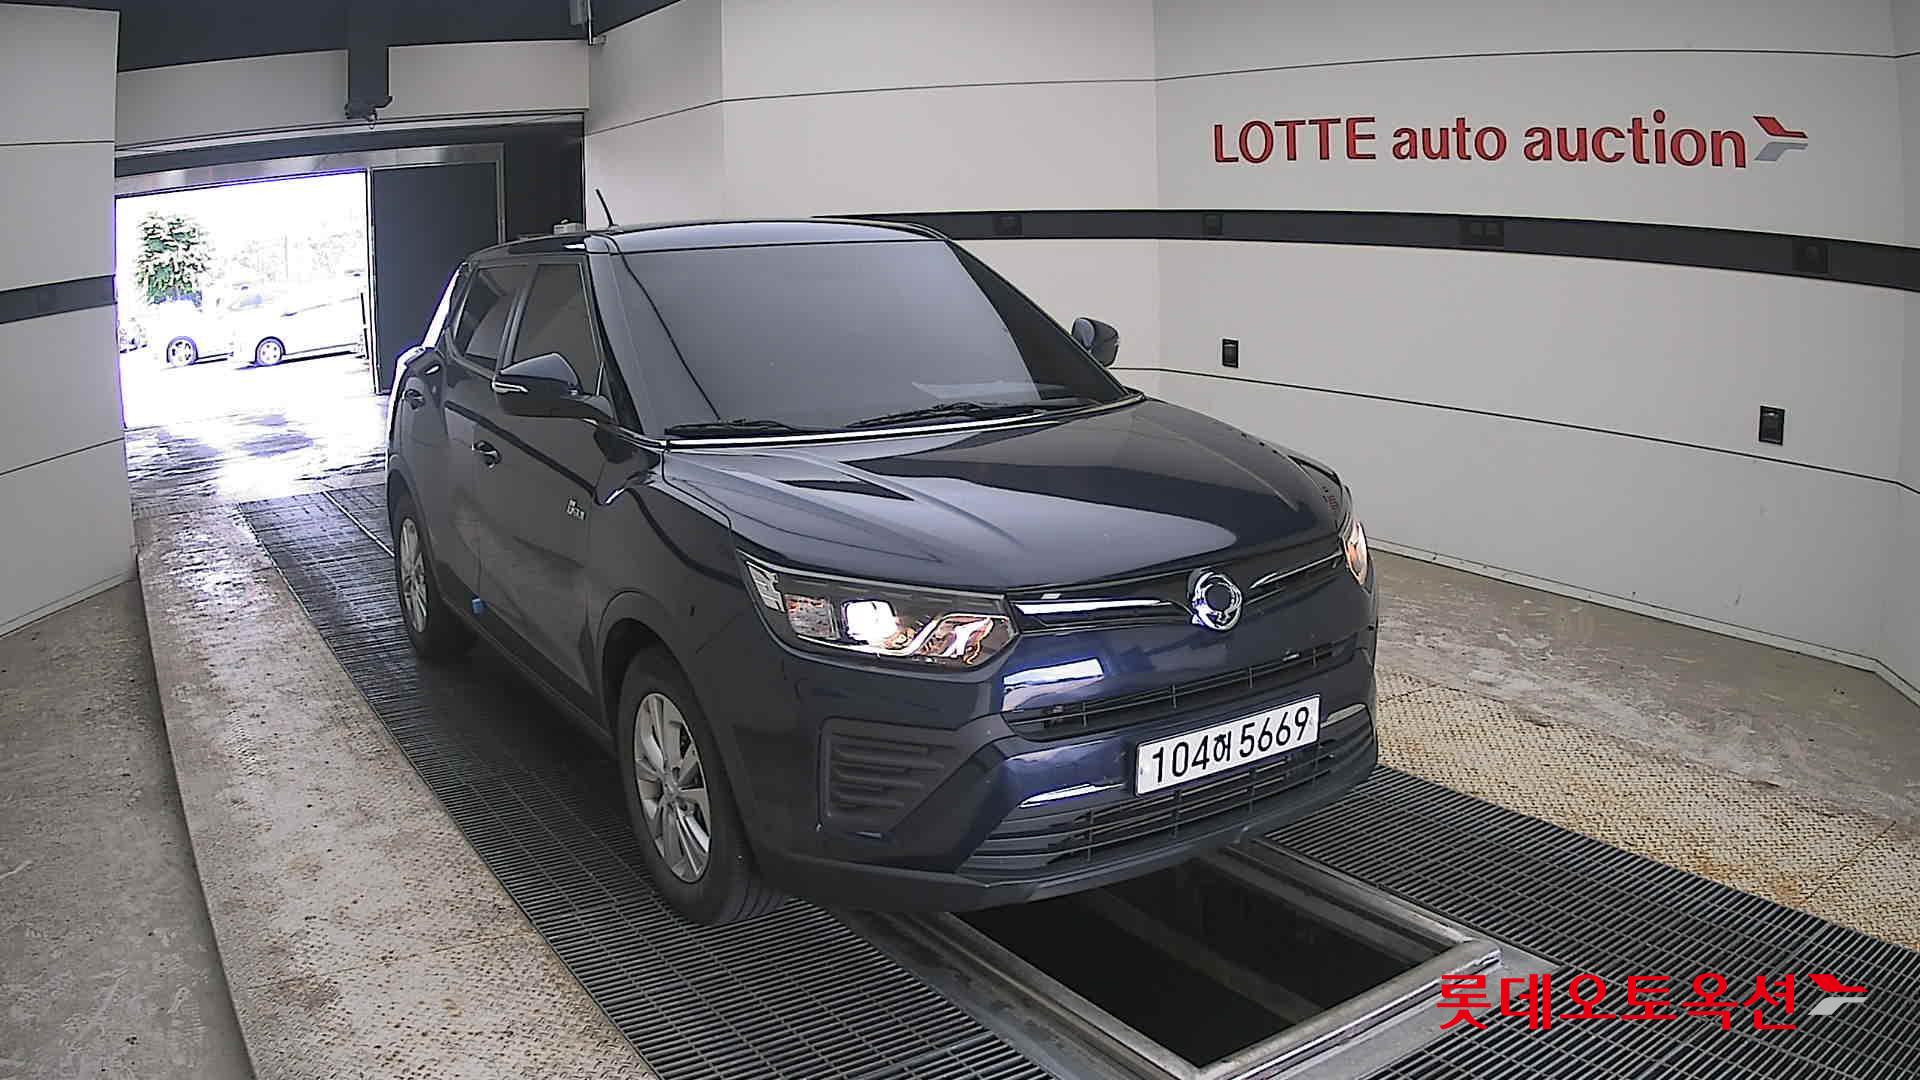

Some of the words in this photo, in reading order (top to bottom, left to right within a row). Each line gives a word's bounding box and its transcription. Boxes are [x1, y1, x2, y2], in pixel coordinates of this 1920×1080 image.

[1213, 116, 1376, 163] LOTTE
[1392, 117, 1507, 161] auto
[1523, 109, 1747, 168] auction
